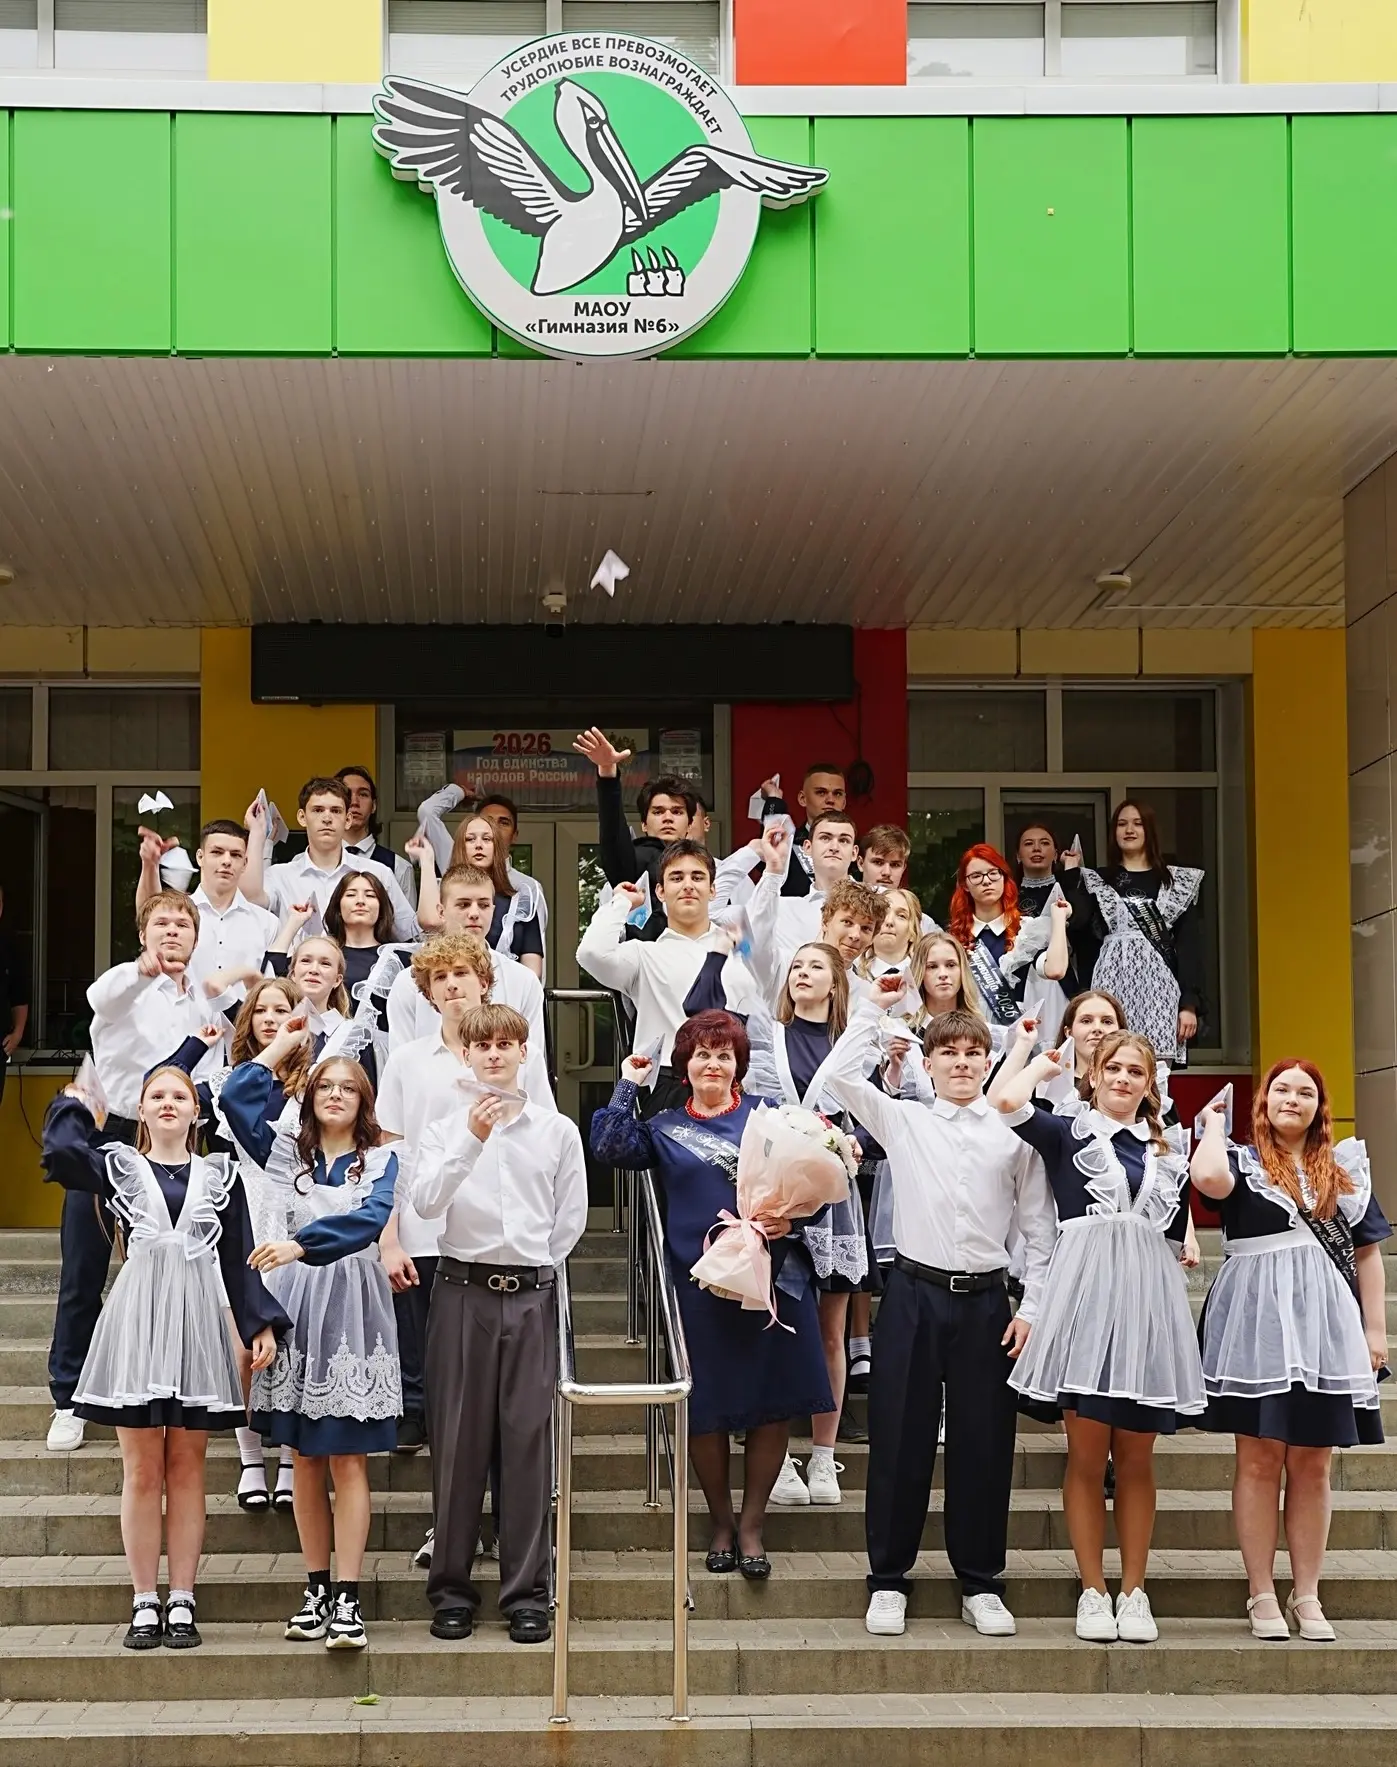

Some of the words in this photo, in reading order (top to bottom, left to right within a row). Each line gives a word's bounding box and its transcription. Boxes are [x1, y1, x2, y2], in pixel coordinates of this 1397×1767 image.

[501, 41, 568, 79] УСЕРДИЕ
[572, 37, 601, 50] ВСЕ
[605, 37, 718, 98] ПРЕВОЗМОГАЕТ
[500, 55, 604, 102] ТРУДОЛЮБИЕ
[609, 56, 723, 134] ВОЗНАГРАЖДАЕТ
[574, 301, 632, 317] МАОУ
[525, 318, 628, 334] «Гимназия
[634, 318, 680, 334] №6»
[492, 732, 552, 755] 2026
[476, 756, 500, 770] Год
[503, 757, 568, 770] единства
[467, 771, 525, 784] народов
[530, 770, 578, 782] России
[994, 991, 1019, 1018] 2026
